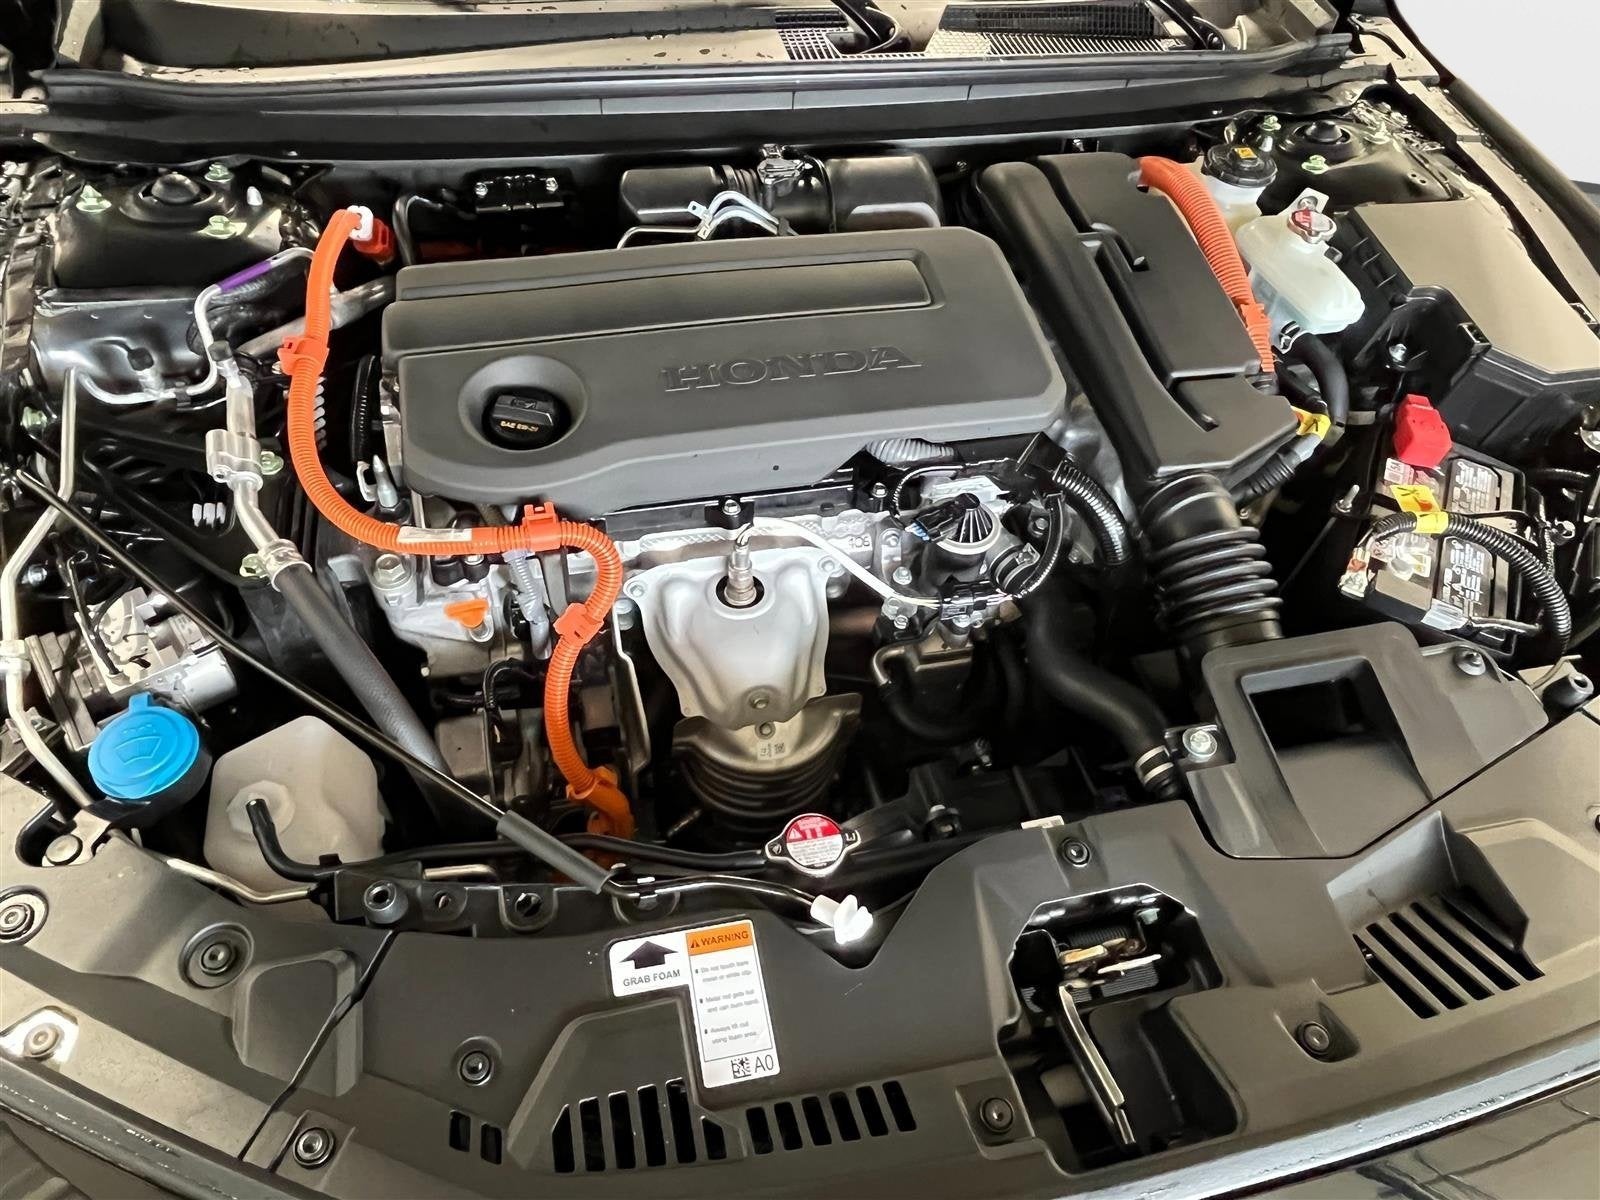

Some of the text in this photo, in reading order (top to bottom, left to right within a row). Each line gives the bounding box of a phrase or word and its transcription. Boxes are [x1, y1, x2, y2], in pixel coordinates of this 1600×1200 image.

[661, 346, 922, 392] HONDA
[701, 931, 749, 946] WARNING
[623, 969, 681, 987] GRAB FOAM
[754, 1054, 774, 1073] A0
